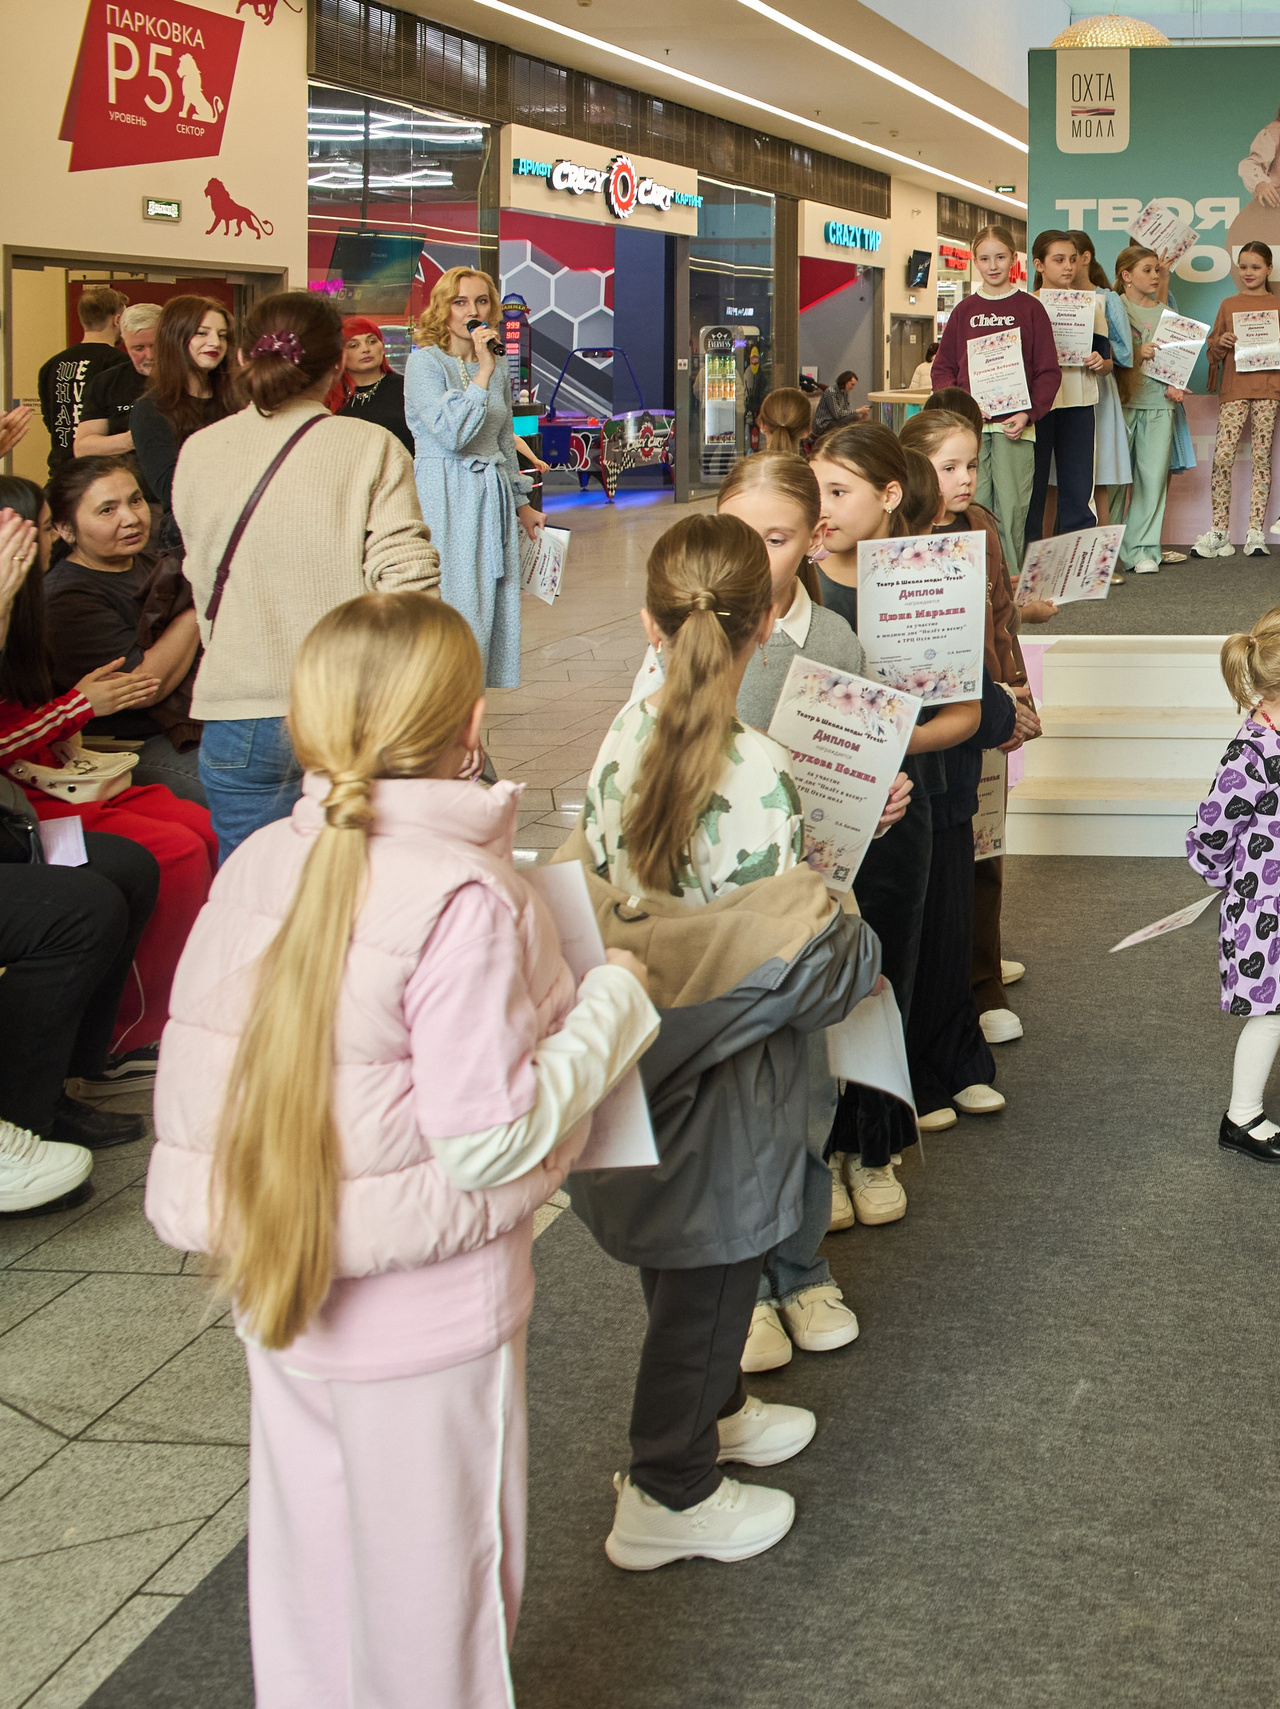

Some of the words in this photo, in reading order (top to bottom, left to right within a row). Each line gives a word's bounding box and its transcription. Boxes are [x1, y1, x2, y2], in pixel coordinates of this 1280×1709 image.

[106, 4, 206, 50] ПАРКОВКА
[1071, 73, 1115, 102] ОХТА
[108, 110, 147, 127] УРОВЕНЬ
[1071, 119, 1115, 138] МОЛЛ
[176, 123, 205, 137] СЕКТОР
[517, 158, 552, 178] ДРИФТ
[551, 160, 610, 196] CRAZY
[637, 178, 675, 211] CART
[675, 191, 704, 208] КАРТИНГ
[1055, 197, 1240, 231] ТВОЯ
[828, 221, 862, 248] CRAZY
[863, 228, 882, 252] ТИР
[970, 313, 1016, 328] Chère
[876, 580, 895, 588] Театр
[899, 587, 944, 600] Диплом
[879, 611, 912, 622] Цюна
[915, 606, 966, 619] Марьяна
[796, 709, 815, 722] Театр
[821, 718, 844, 731] Школа
[844, 725, 863, 737] моды
[812, 729, 861, 752] Диплом
[834, 762, 877, 784] Полина
